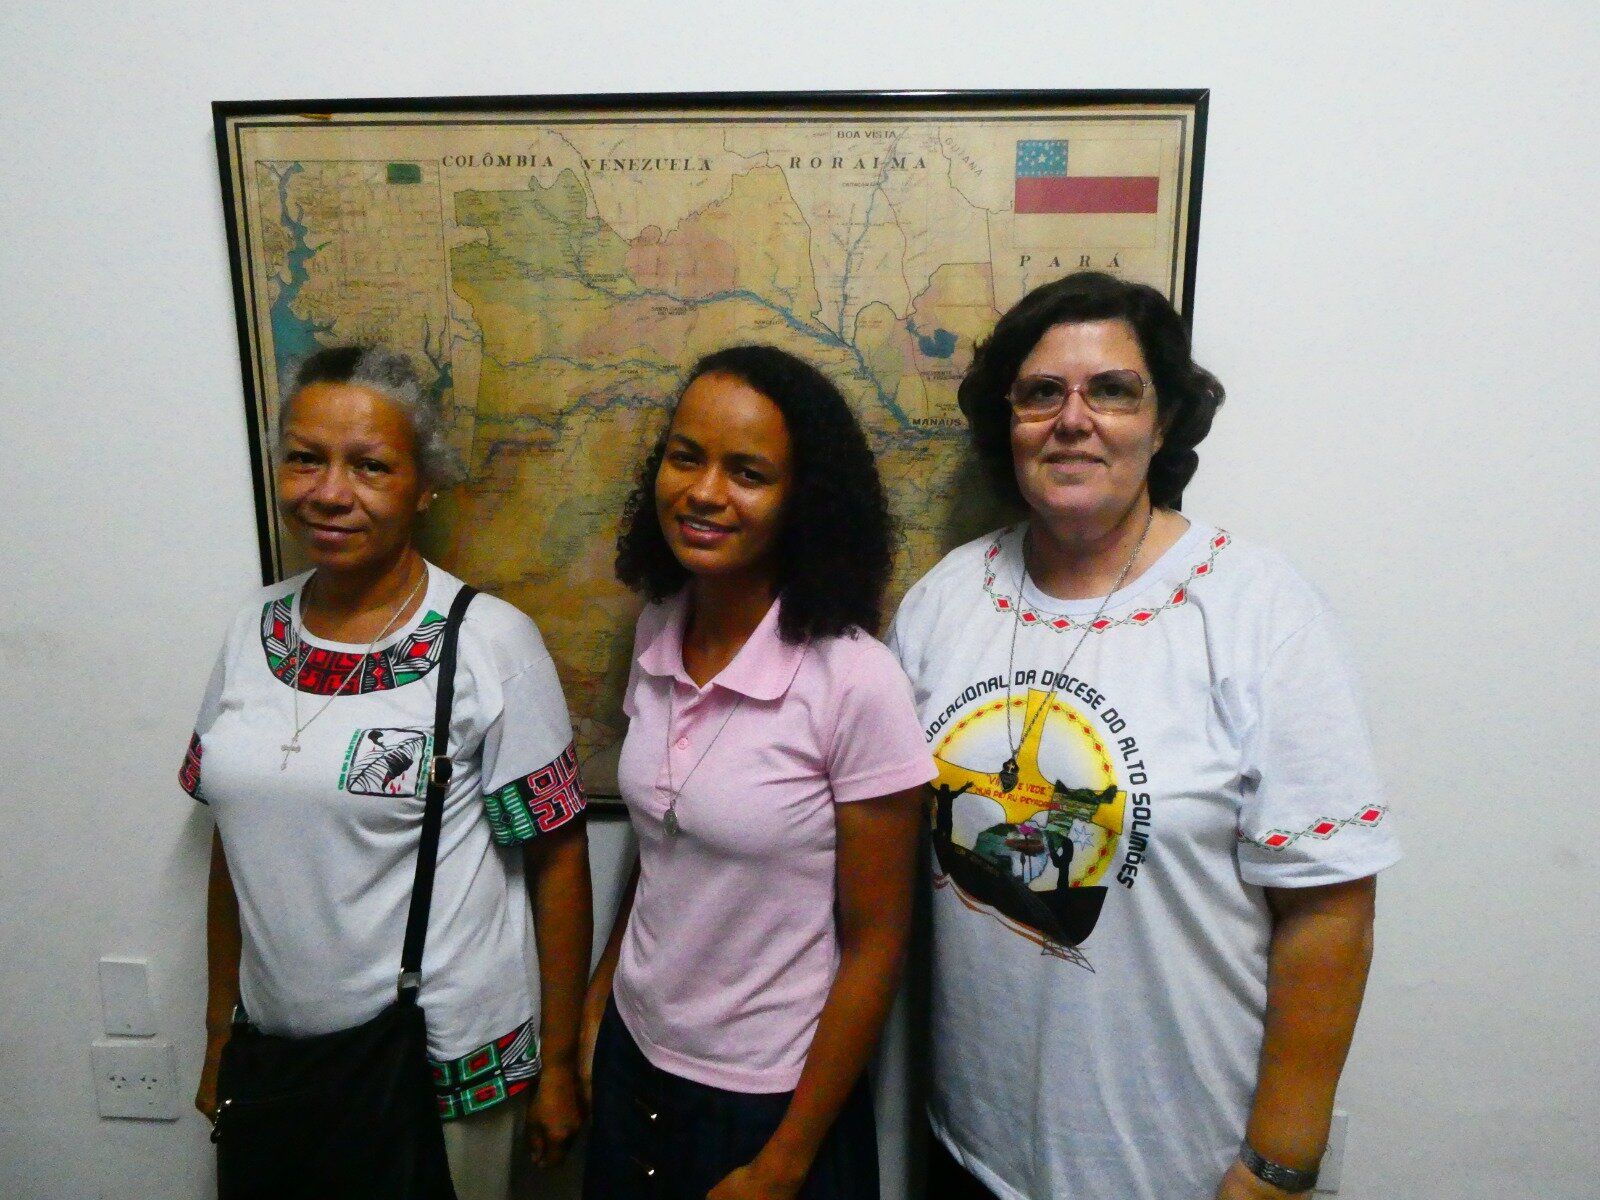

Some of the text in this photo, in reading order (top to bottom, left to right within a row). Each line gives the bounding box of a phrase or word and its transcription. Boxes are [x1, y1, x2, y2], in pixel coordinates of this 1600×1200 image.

[837, 130, 896, 139] BOA VISTA
[442, 152, 554, 167] COLÔMBIA
[582, 158, 712, 171] VENEZUELA
[790, 156, 928, 169] RORAIMA
[1019, 252, 1121, 268] PARÁ
[912, 418, 962, 426] MANAUS
[1015, 669, 1037, 686] DA
[1041, 669, 1105, 710] DIOCESE
[1100, 708, 1126, 734] DO
[1117, 736, 1148, 786] ALTO
[1116, 792, 1151, 889] SOLIMÕES
